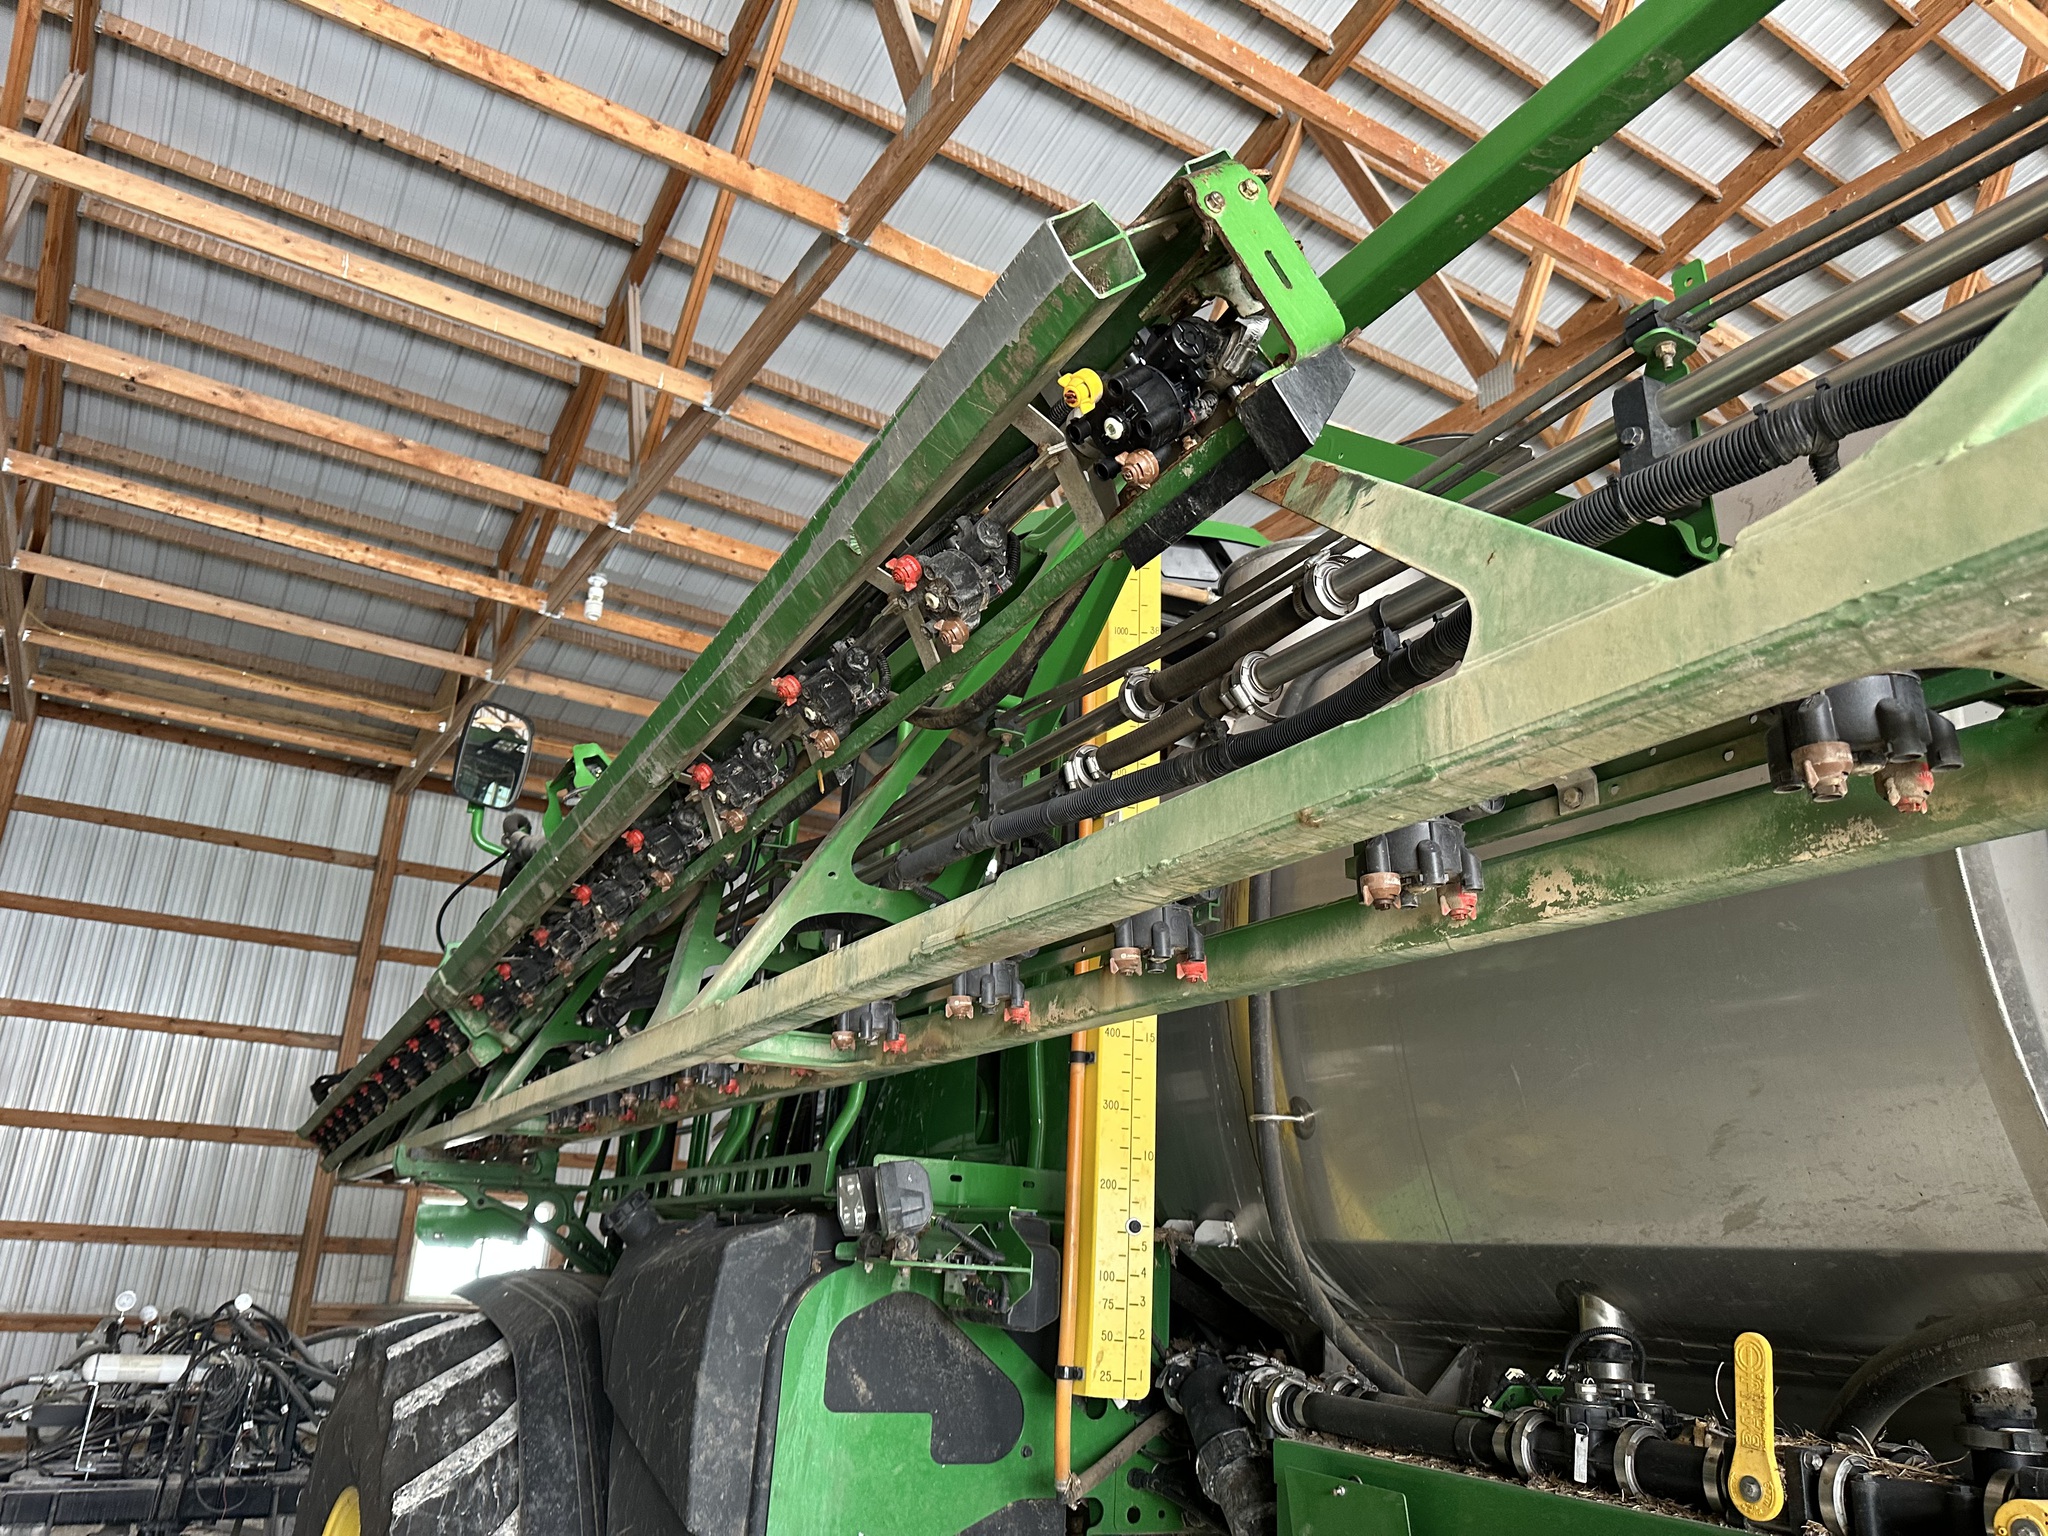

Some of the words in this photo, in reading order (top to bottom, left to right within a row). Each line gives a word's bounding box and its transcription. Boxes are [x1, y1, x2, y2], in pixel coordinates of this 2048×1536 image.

[1114, 626, 1129, 635] 1000
[1150, 626, 1160, 635] 38
[1104, 1027, 1121, 1038] 400
[1145, 1033, 1156, 1043] 15
[1102, 1100, 1120, 1111] 300
[1143, 1150, 1154, 1161] 10
[1100, 1179, 1117, 1190] 200
[1141, 1241, 1148, 1252] 5
[1099, 1270, 1115, 1282] 100
[1140, 1267, 1147, 1278] 4
[1102, 1298, 1114, 1310] 75
[1140, 1296, 1146, 1307] 3
[1101, 1330, 1114, 1341] 50
[1139, 1329, 1145, 1340] 2
[1100, 1370, 1112, 1382] 25
